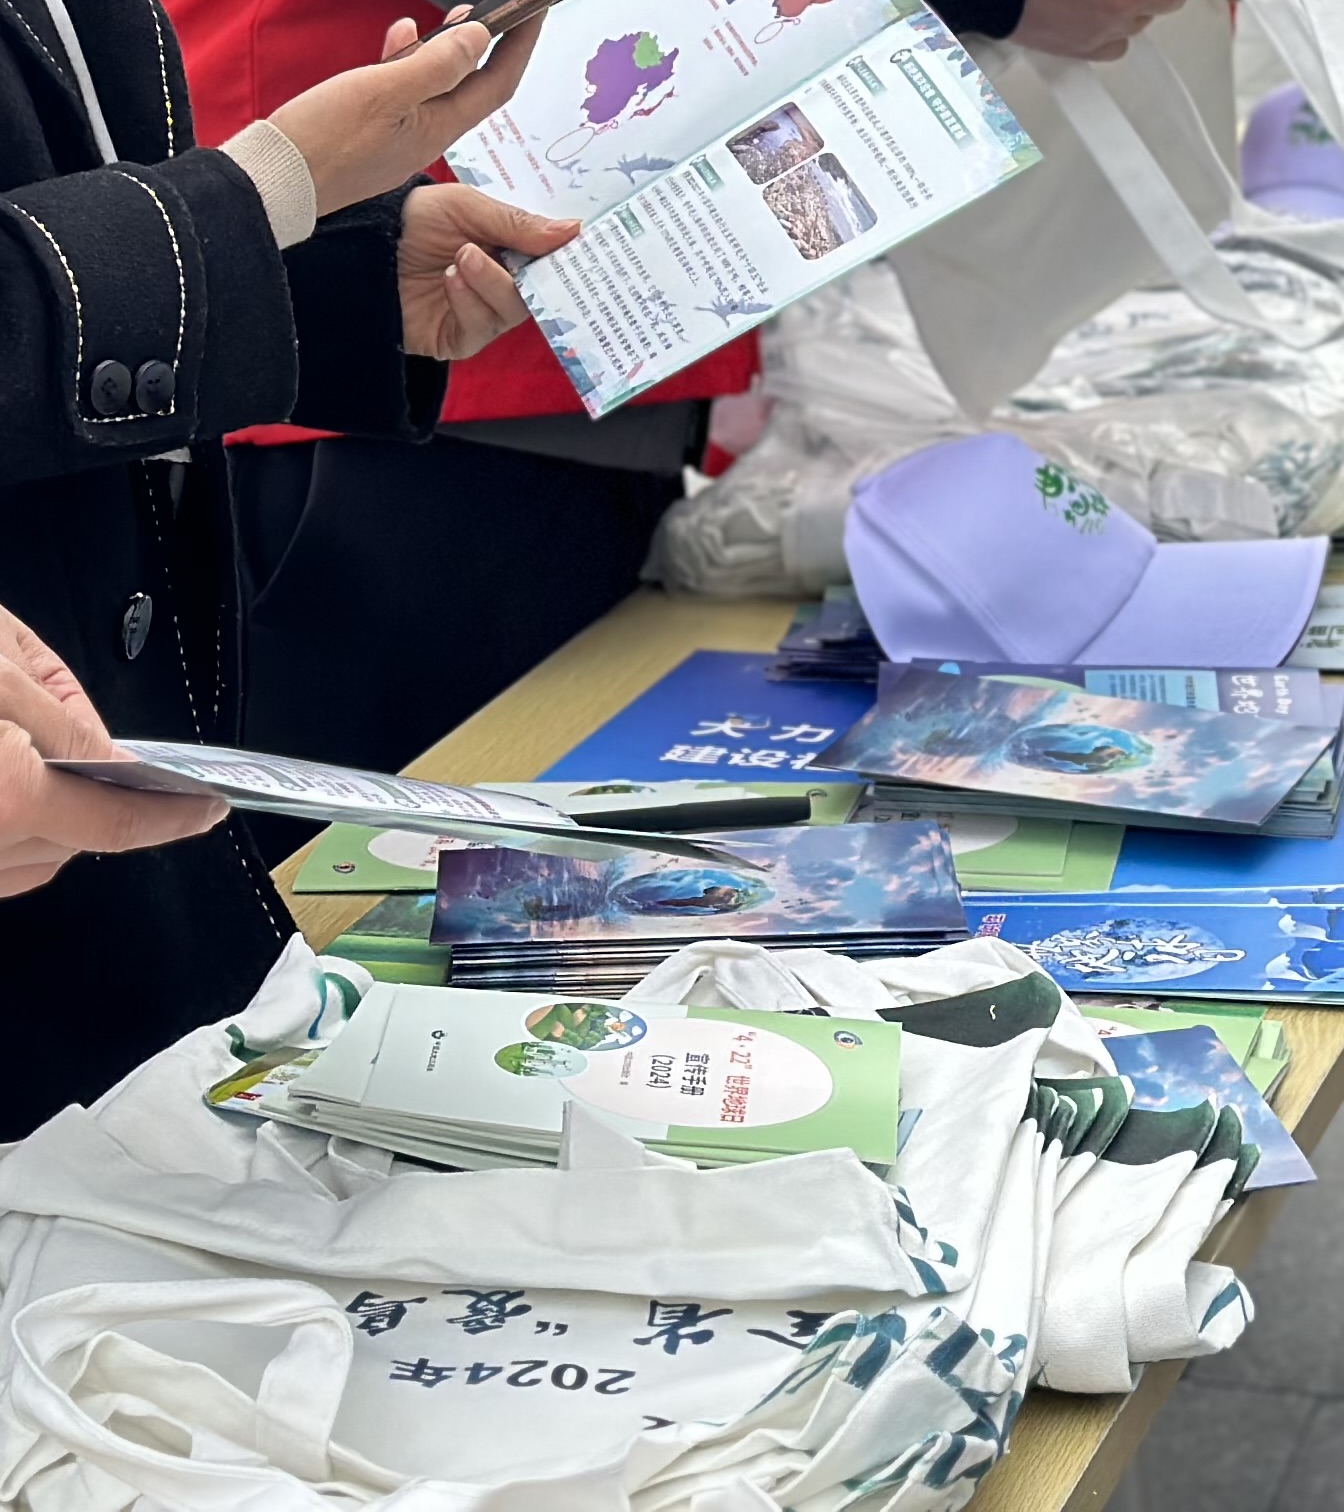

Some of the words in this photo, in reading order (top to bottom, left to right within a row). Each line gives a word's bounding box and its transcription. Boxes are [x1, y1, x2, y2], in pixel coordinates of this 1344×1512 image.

[1274, 698, 1293, 715] Day
[645, 1054, 676, 1089] (2024)
[680, 1051, 711, 1097] 宣传手册
[719, 1075, 751, 1124] 世界地球日
[388, 1356, 637, 1396] 2024年
